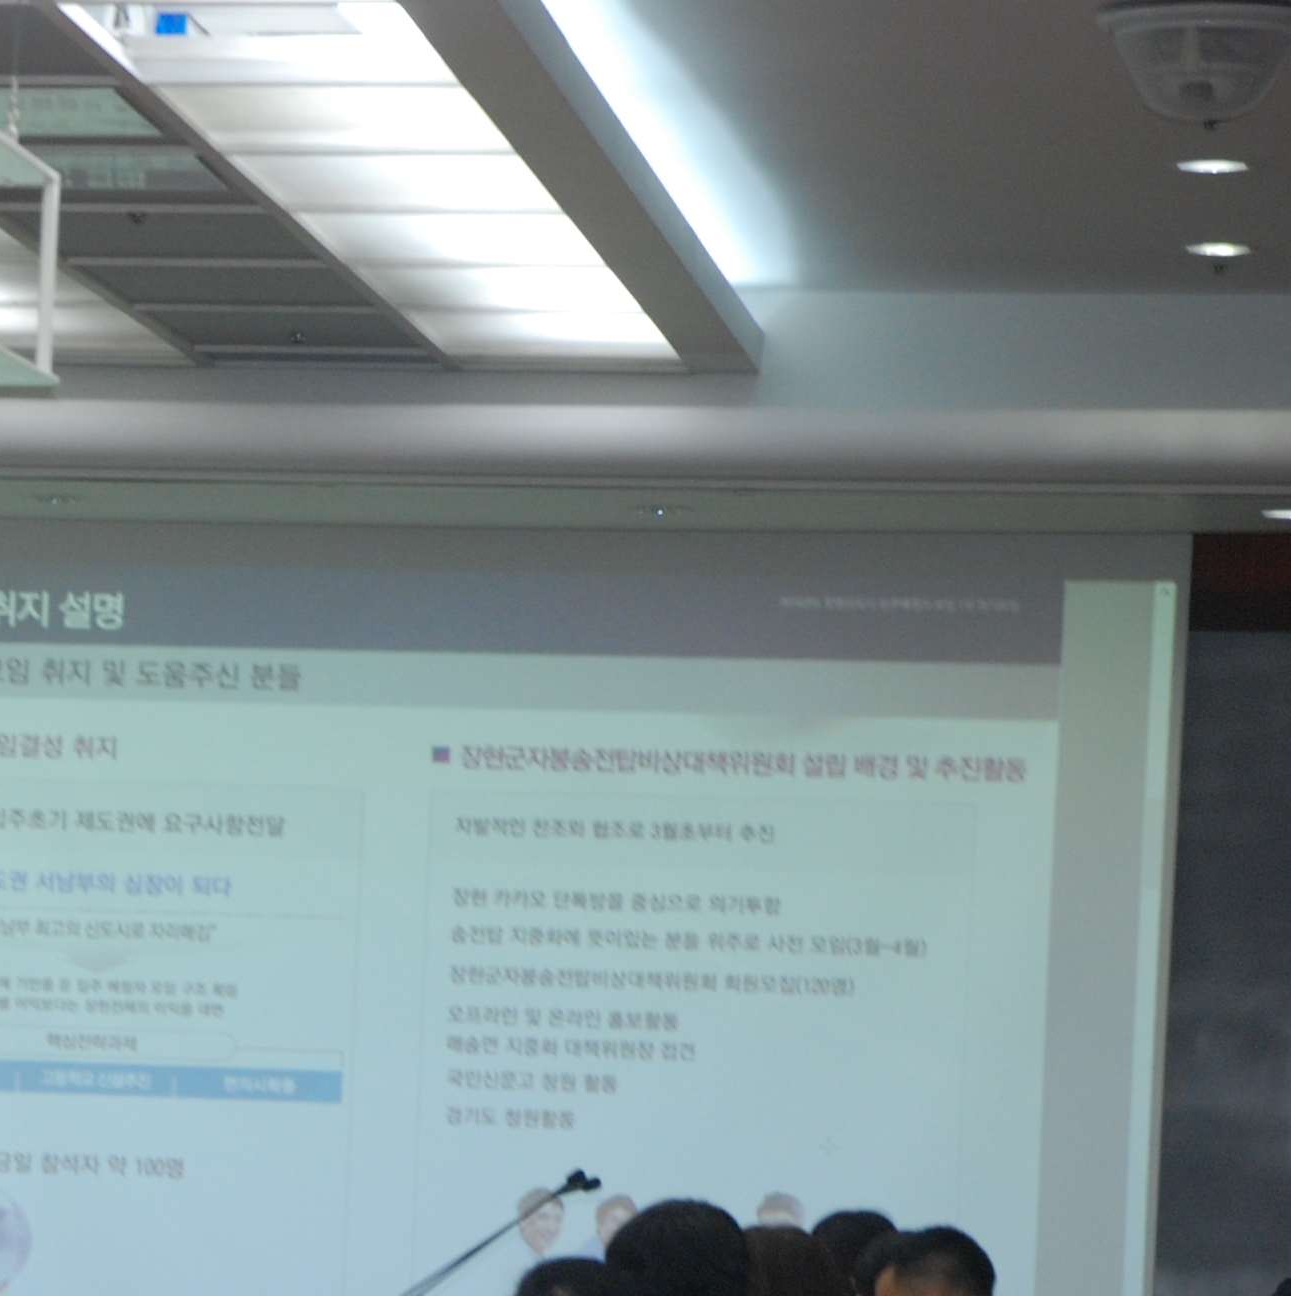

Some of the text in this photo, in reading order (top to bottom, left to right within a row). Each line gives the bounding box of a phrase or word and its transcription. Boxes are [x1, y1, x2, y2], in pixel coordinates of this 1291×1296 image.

[58, 591, 125, 631] 설명
[42, 660, 91, 686] 취지
[103, 660, 125, 687] 및
[136, 661, 238, 689] 도움주신
[250, 663, 301, 691] 분들
[74, 736, 117, 760] 취지
